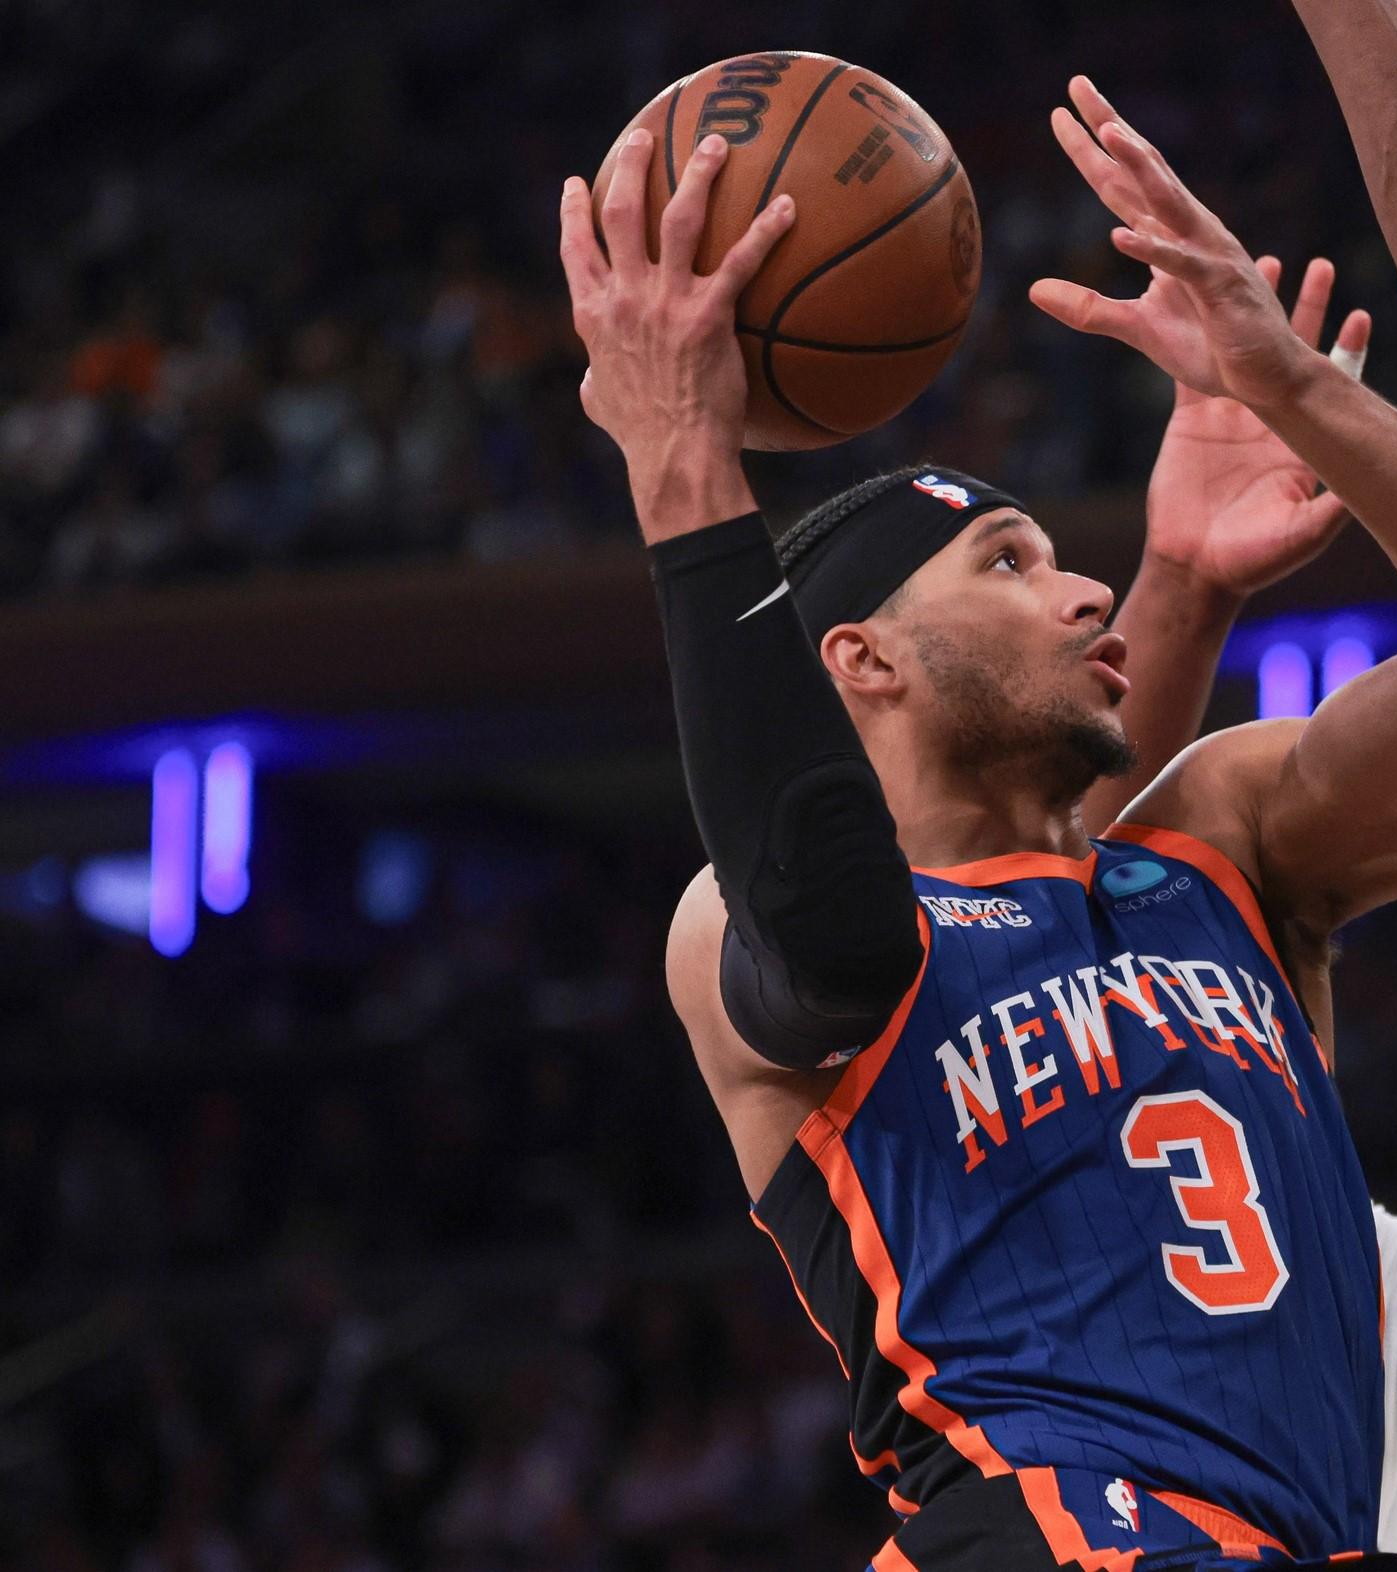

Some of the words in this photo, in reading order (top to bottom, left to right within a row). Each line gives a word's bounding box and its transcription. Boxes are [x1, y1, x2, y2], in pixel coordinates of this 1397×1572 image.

[919, 895, 1032, 929] NYC
[1114, 876, 1191, 912] sphere
[935, 964, 1122, 1175] NEW
[1100, 952, 1306, 1117] YORK
[1121, 1089, 1290, 1315] 3
